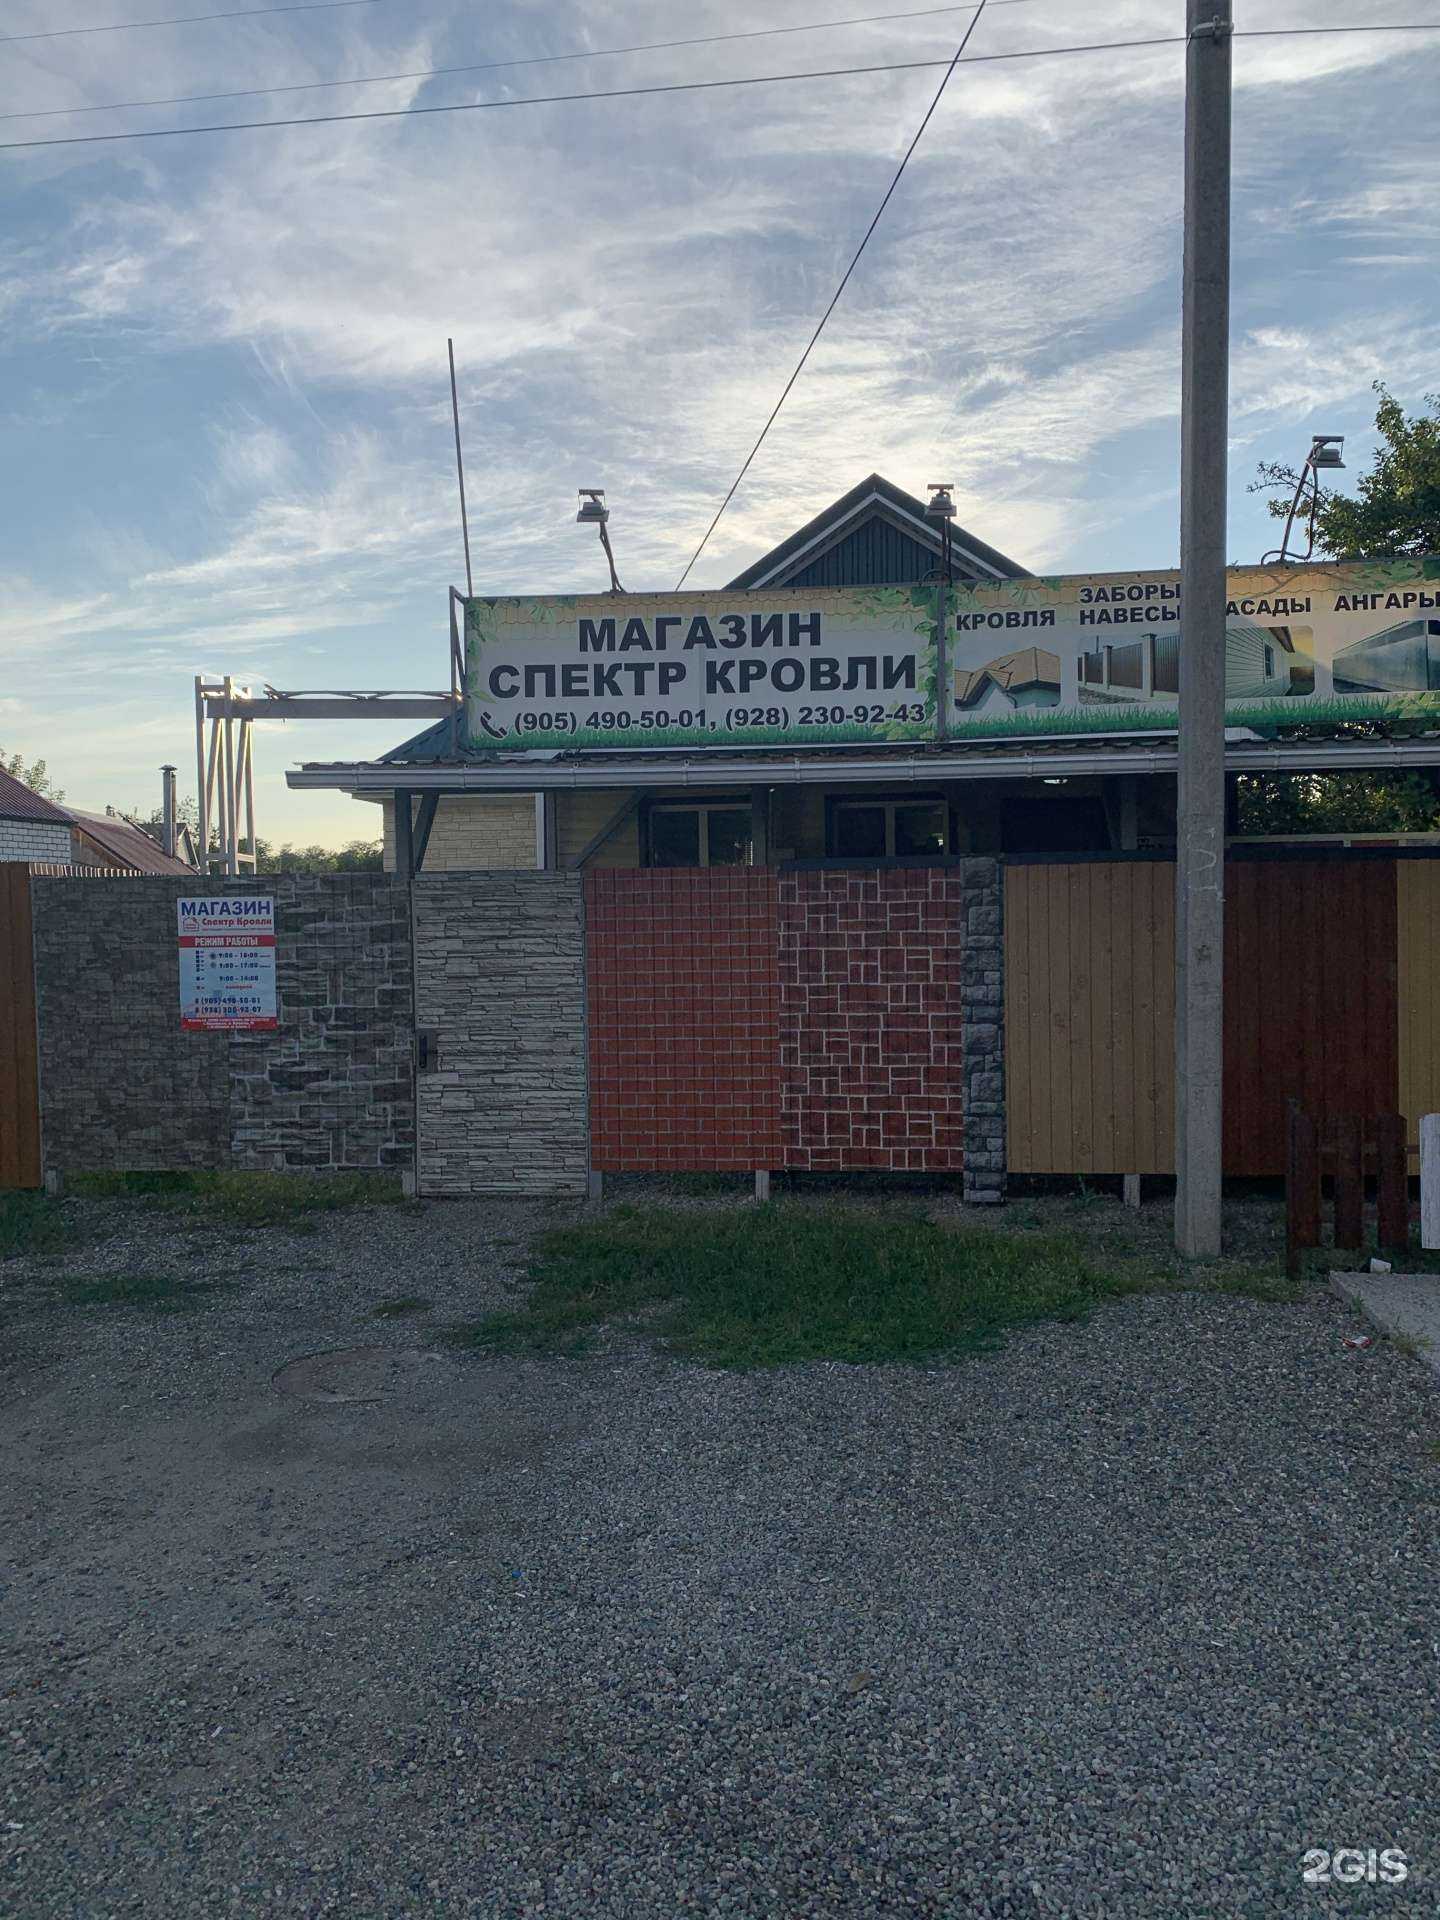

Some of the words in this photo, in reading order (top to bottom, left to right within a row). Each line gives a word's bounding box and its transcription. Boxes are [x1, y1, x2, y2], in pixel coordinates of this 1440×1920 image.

[1079, 584, 1181, 604] ЗАБОРЫ
[1334, 591, 1440, 611] АНГАРЫ
[1079, 605, 1181, 626] НАВЕСЫ
[1226, 597, 1312, 618] АСАДЫ
[956, 609, 1056, 631] КРОВЛЯ
[578, 612, 821, 653] МАГАЗИН
[488, 661, 687, 699] СПЕКТР
[705, 655, 917, 695] КРОВЛИ
[514, 711, 577, 732] (905)
[585, 708, 717, 731] 490-50-01,
[725, 706, 790, 729] (928)
[798, 704, 926, 726] 230-92-43
[181, 901, 271, 916] МАГАЗИН
[194, 937, 225, 946] РЕЖИМ
[226, 936, 258, 946] РАБОТЫ
